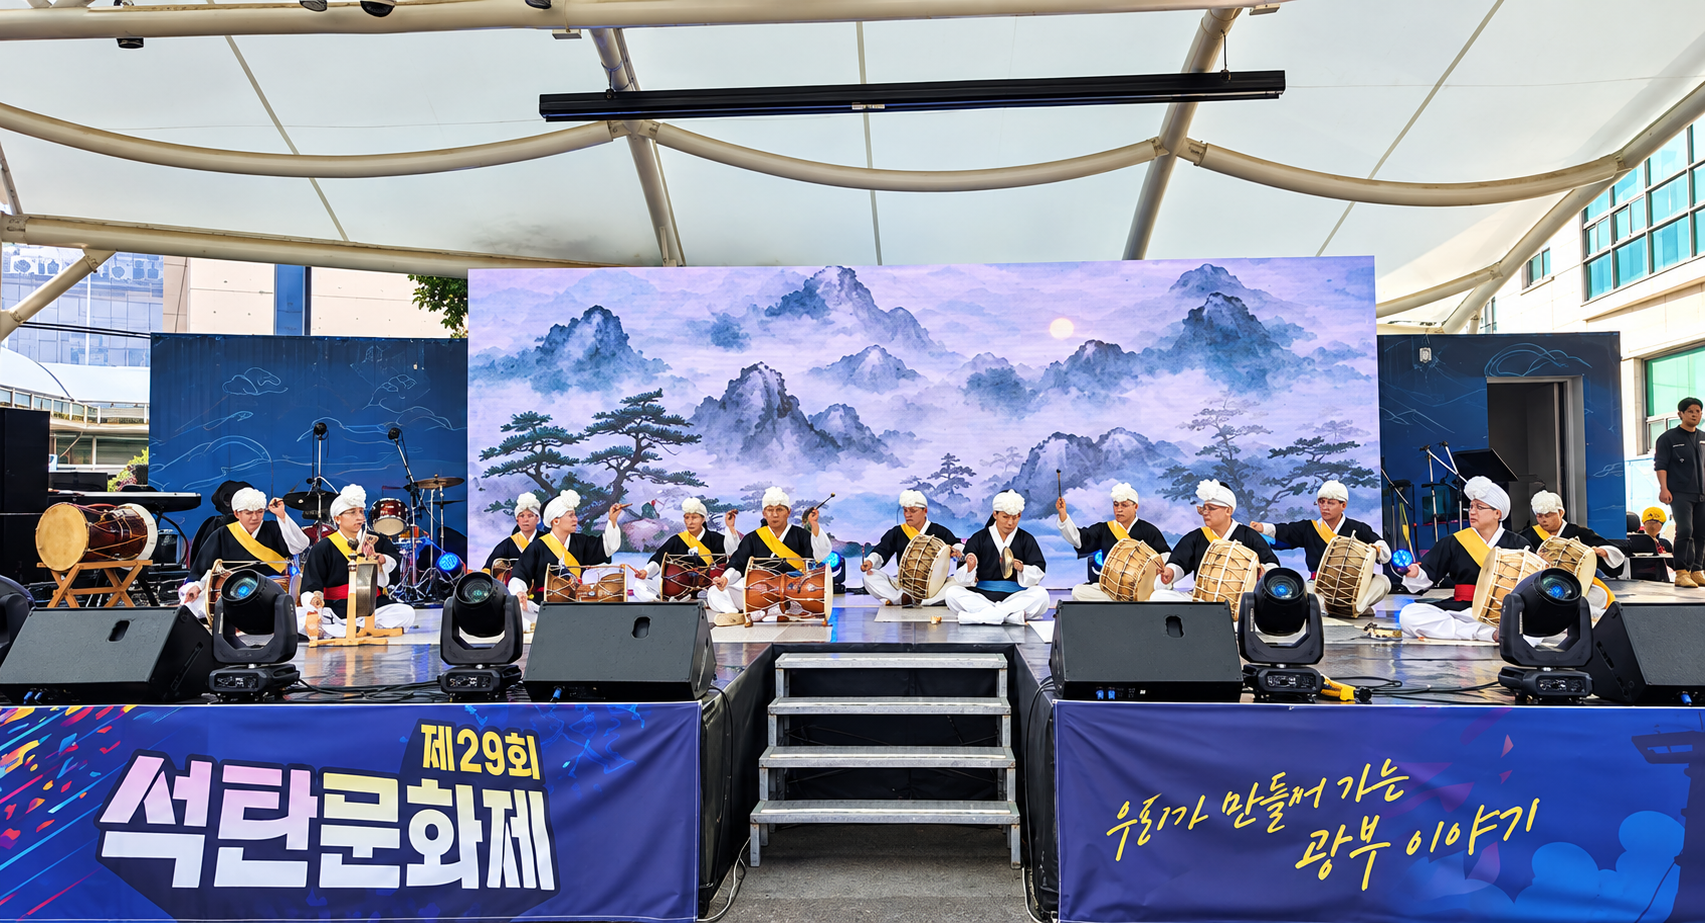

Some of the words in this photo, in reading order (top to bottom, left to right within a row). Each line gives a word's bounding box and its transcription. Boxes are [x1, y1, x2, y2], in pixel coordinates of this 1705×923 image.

[420, 724, 540, 780] 제29회
[1337, 758, 1410, 802] 가는
[99, 755, 556, 890] 석탄문화제
[1295, 815, 1391, 891] 광부
[1406, 798, 1540, 855] 이야기
